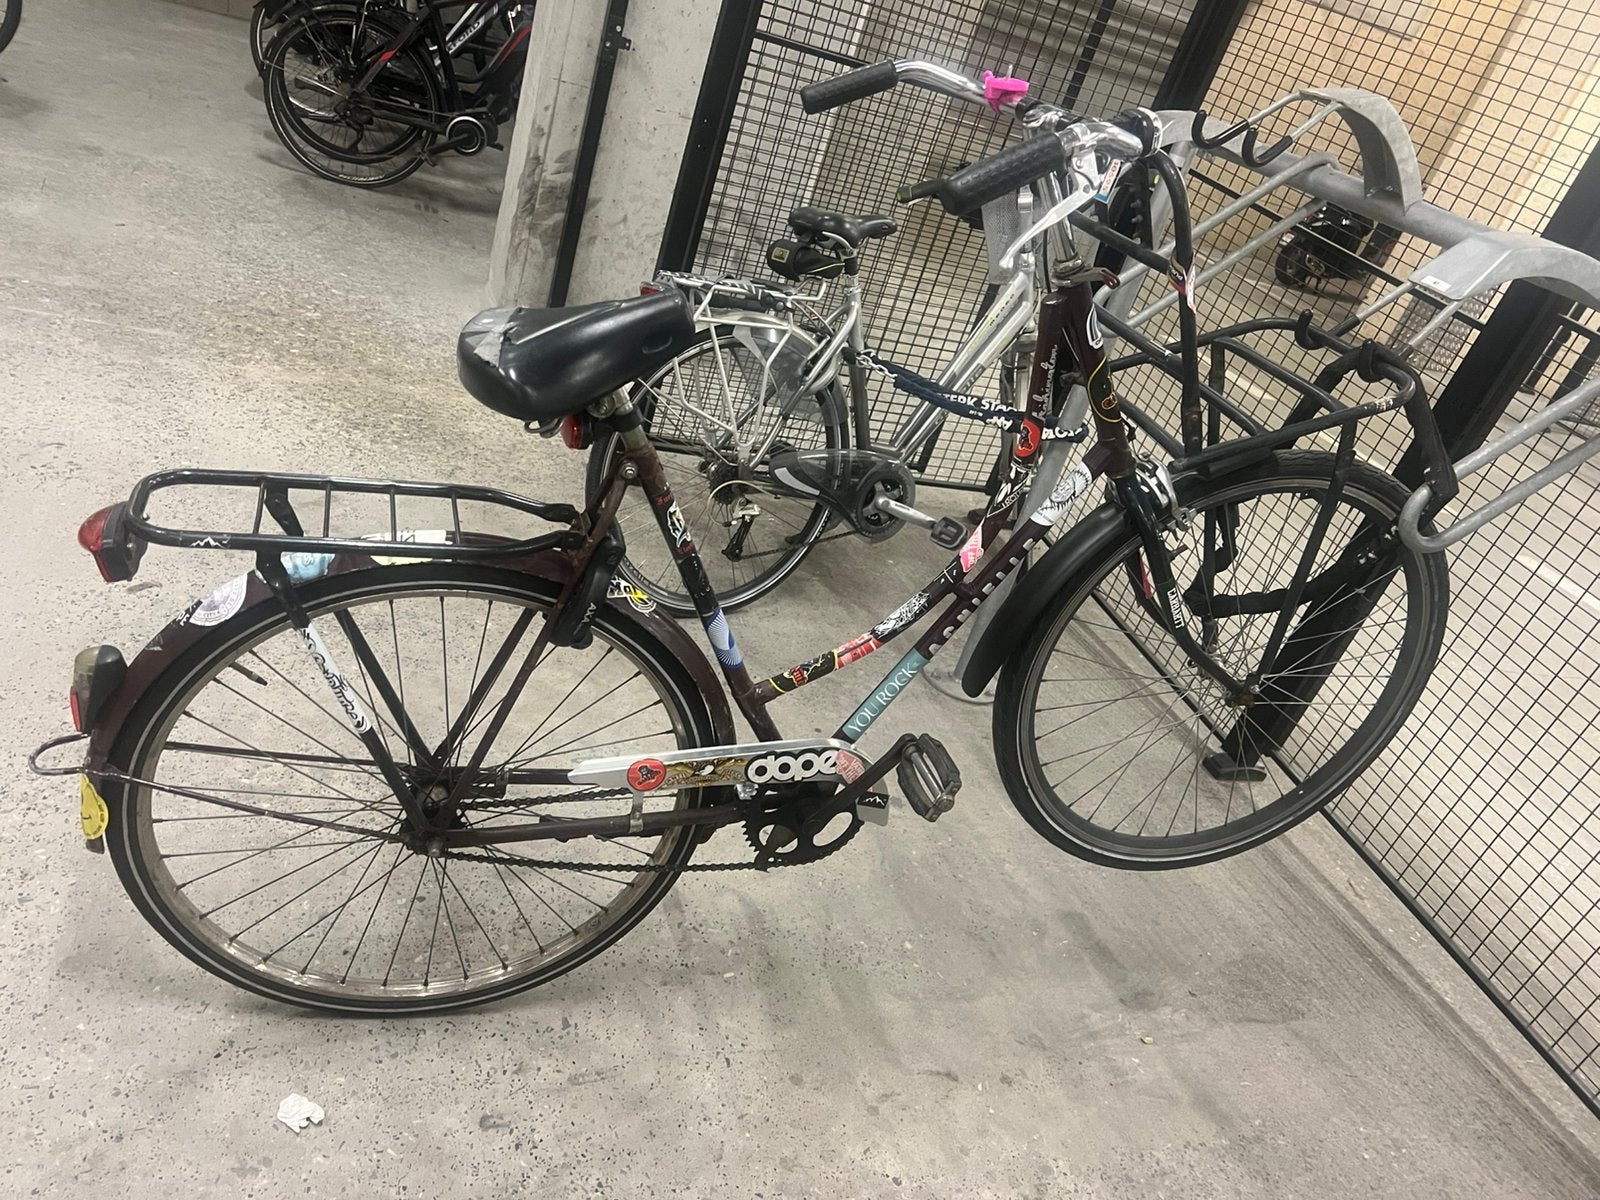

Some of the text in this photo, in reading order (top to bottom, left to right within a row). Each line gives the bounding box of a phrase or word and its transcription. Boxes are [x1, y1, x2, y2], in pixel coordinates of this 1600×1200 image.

[582, 602, 597, 623] AXA
[848, 702, 880, 733] YOU
[875, 663, 917, 705] ROCK
[748, 749, 838, 783] dope
